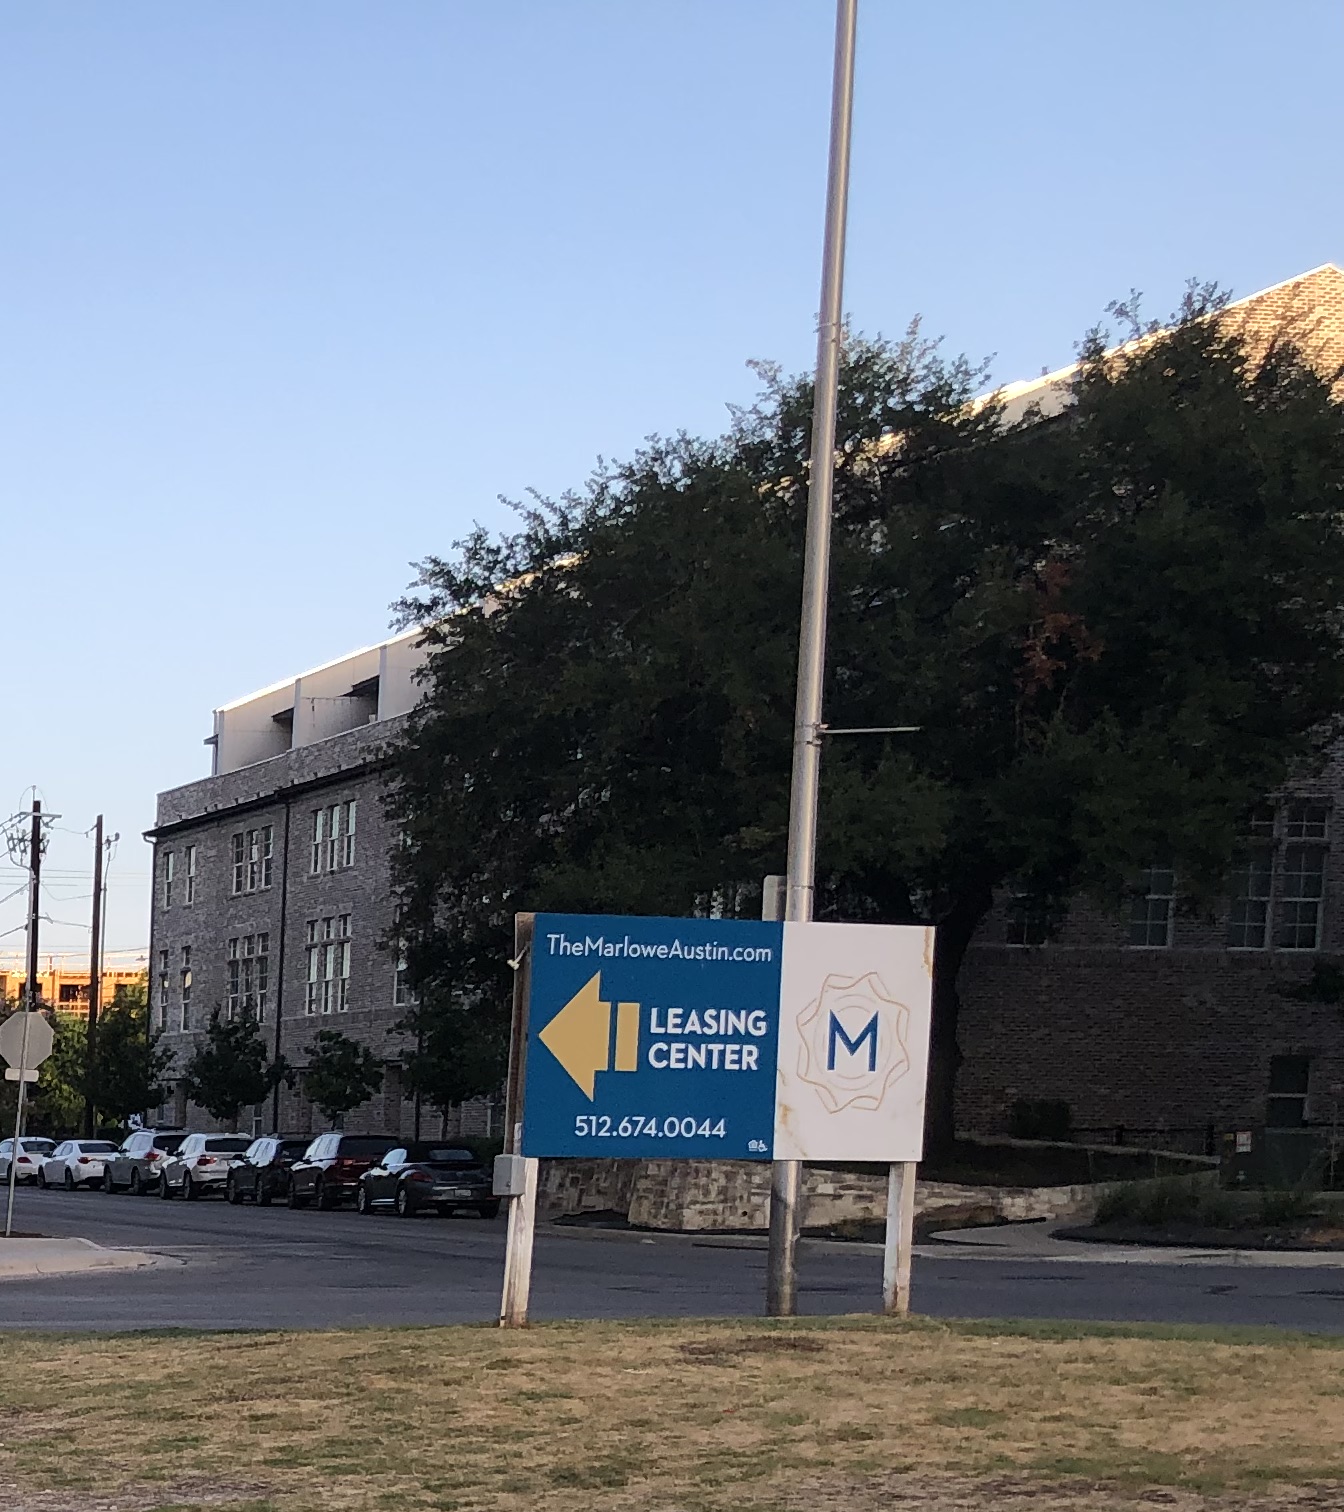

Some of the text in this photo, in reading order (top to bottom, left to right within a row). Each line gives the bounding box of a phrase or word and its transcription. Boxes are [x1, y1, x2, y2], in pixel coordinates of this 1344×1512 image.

[546, 933, 772, 962] TheMarloweAustin.com
[649, 1007, 767, 1037] LEASING
[827, 1009, 879, 1072] M
[648, 1042, 758, 1071] CENTER
[574, 1115, 727, 1139] 512.674.0044
